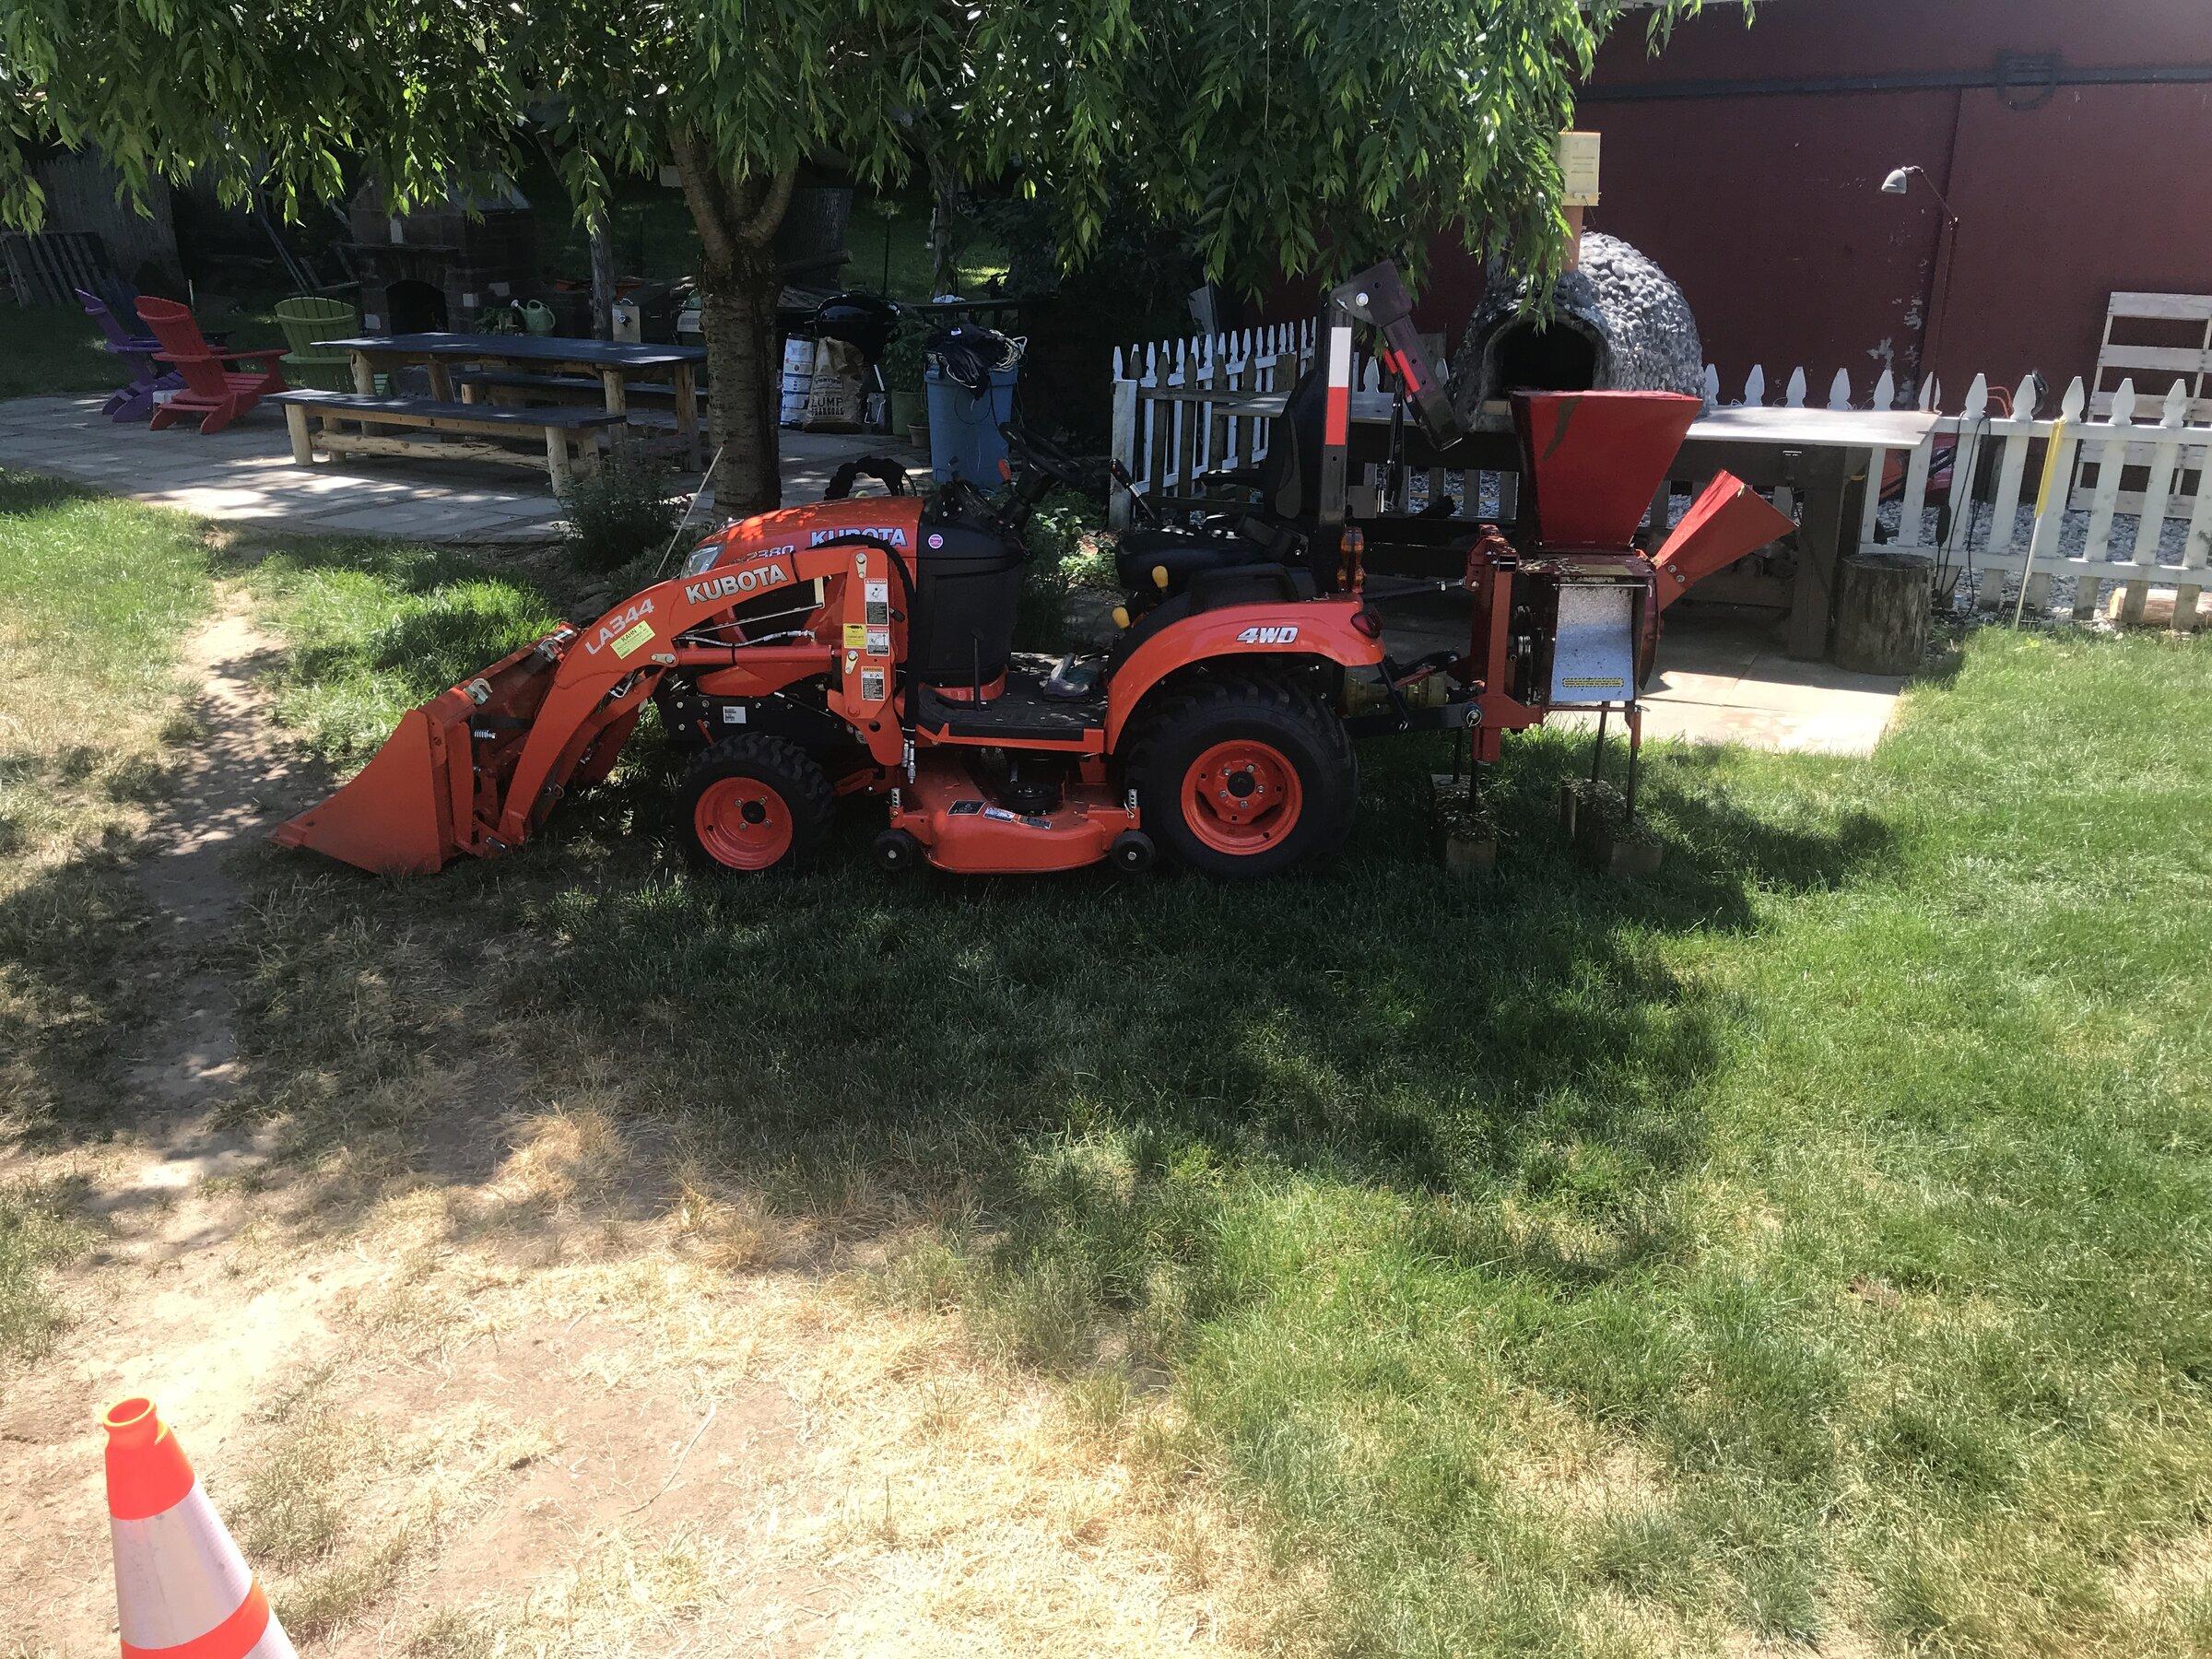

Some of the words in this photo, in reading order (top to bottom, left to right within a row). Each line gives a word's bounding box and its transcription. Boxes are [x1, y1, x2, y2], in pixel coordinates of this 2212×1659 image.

[811, 396, 843, 407] LUMP
[684, 564, 788, 605] KUBOTA
[584, 598, 655, 655] LA344
[620, 628, 637, 642] KAHN
[1236, 627, 1299, 644] 4WD
